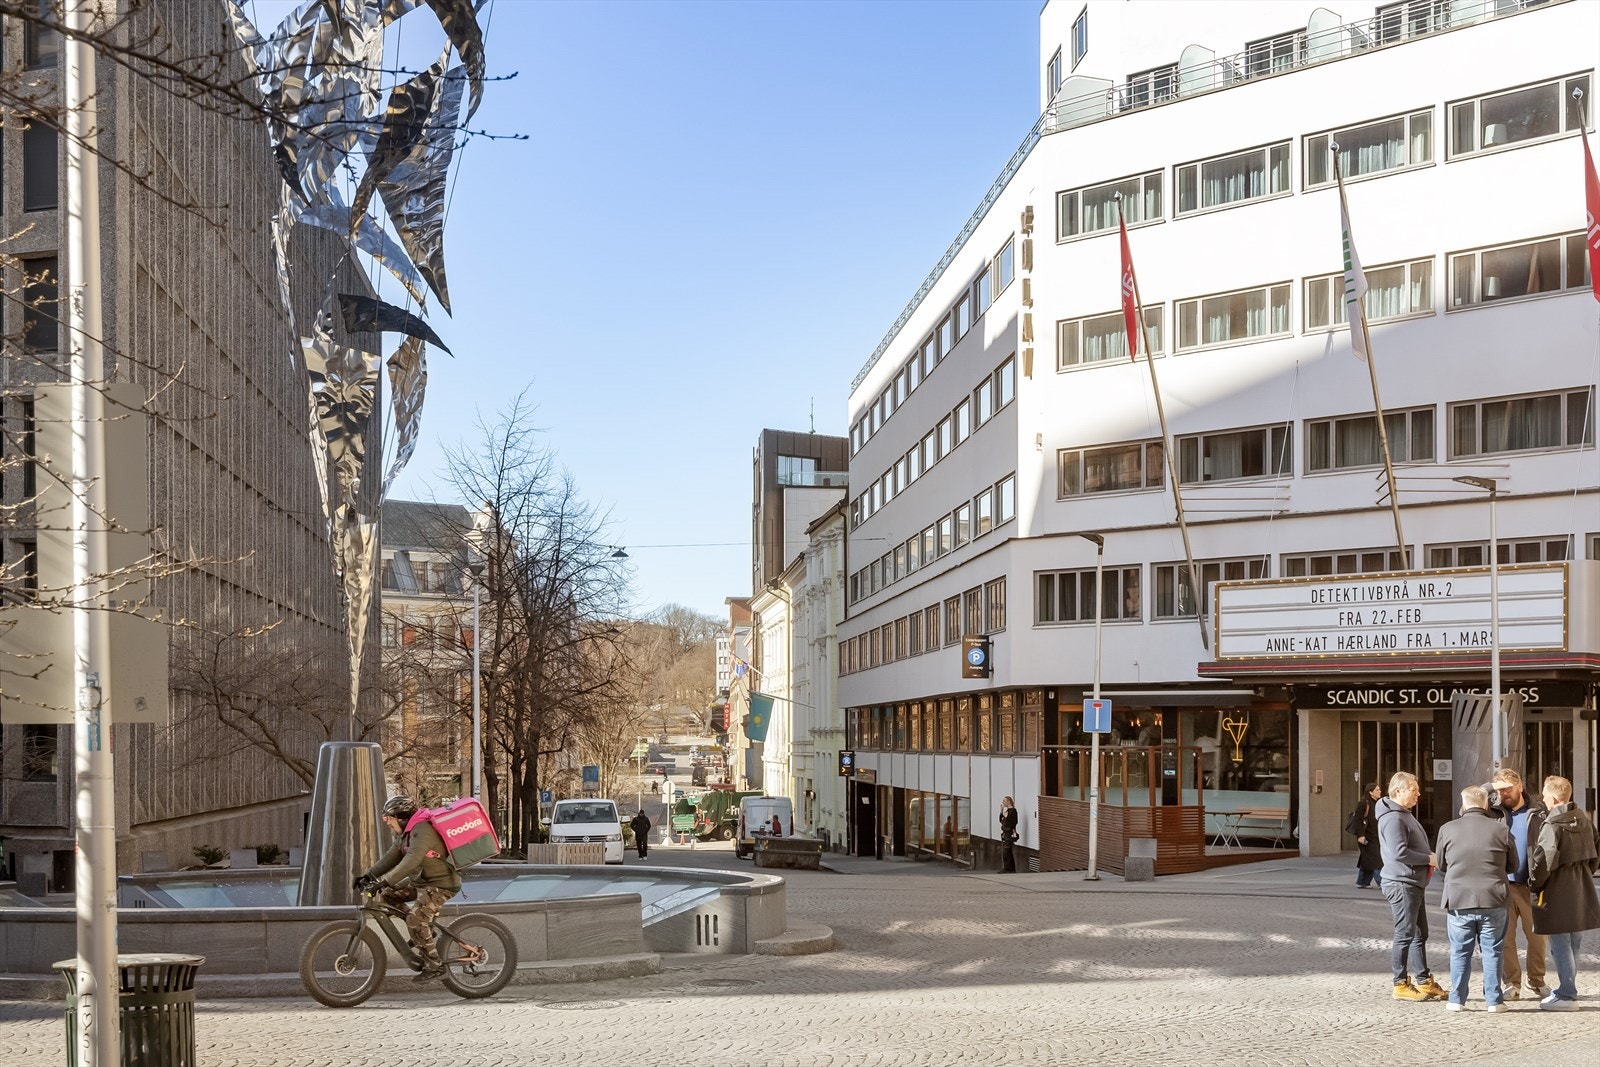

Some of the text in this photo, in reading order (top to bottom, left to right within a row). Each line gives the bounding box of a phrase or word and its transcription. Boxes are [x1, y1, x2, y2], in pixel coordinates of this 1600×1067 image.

[1311, 580, 1452, 603] DETEKTIVBYRÅ NR.2
[1339, 608, 1421, 626] FRA 22.FEB
[1266, 637, 1327, 652] ANNE-KAT
[1337, 634, 1397, 649] HÆRLAND
[1407, 633, 1432, 648] FRA
[973, 653, 980, 662] P
[1327, 690, 1394, 705] SCANDIC
[1399, 689, 1421, 704] ST.
[542, 792, 549, 802] P
[446, 818, 483, 838] foodora
